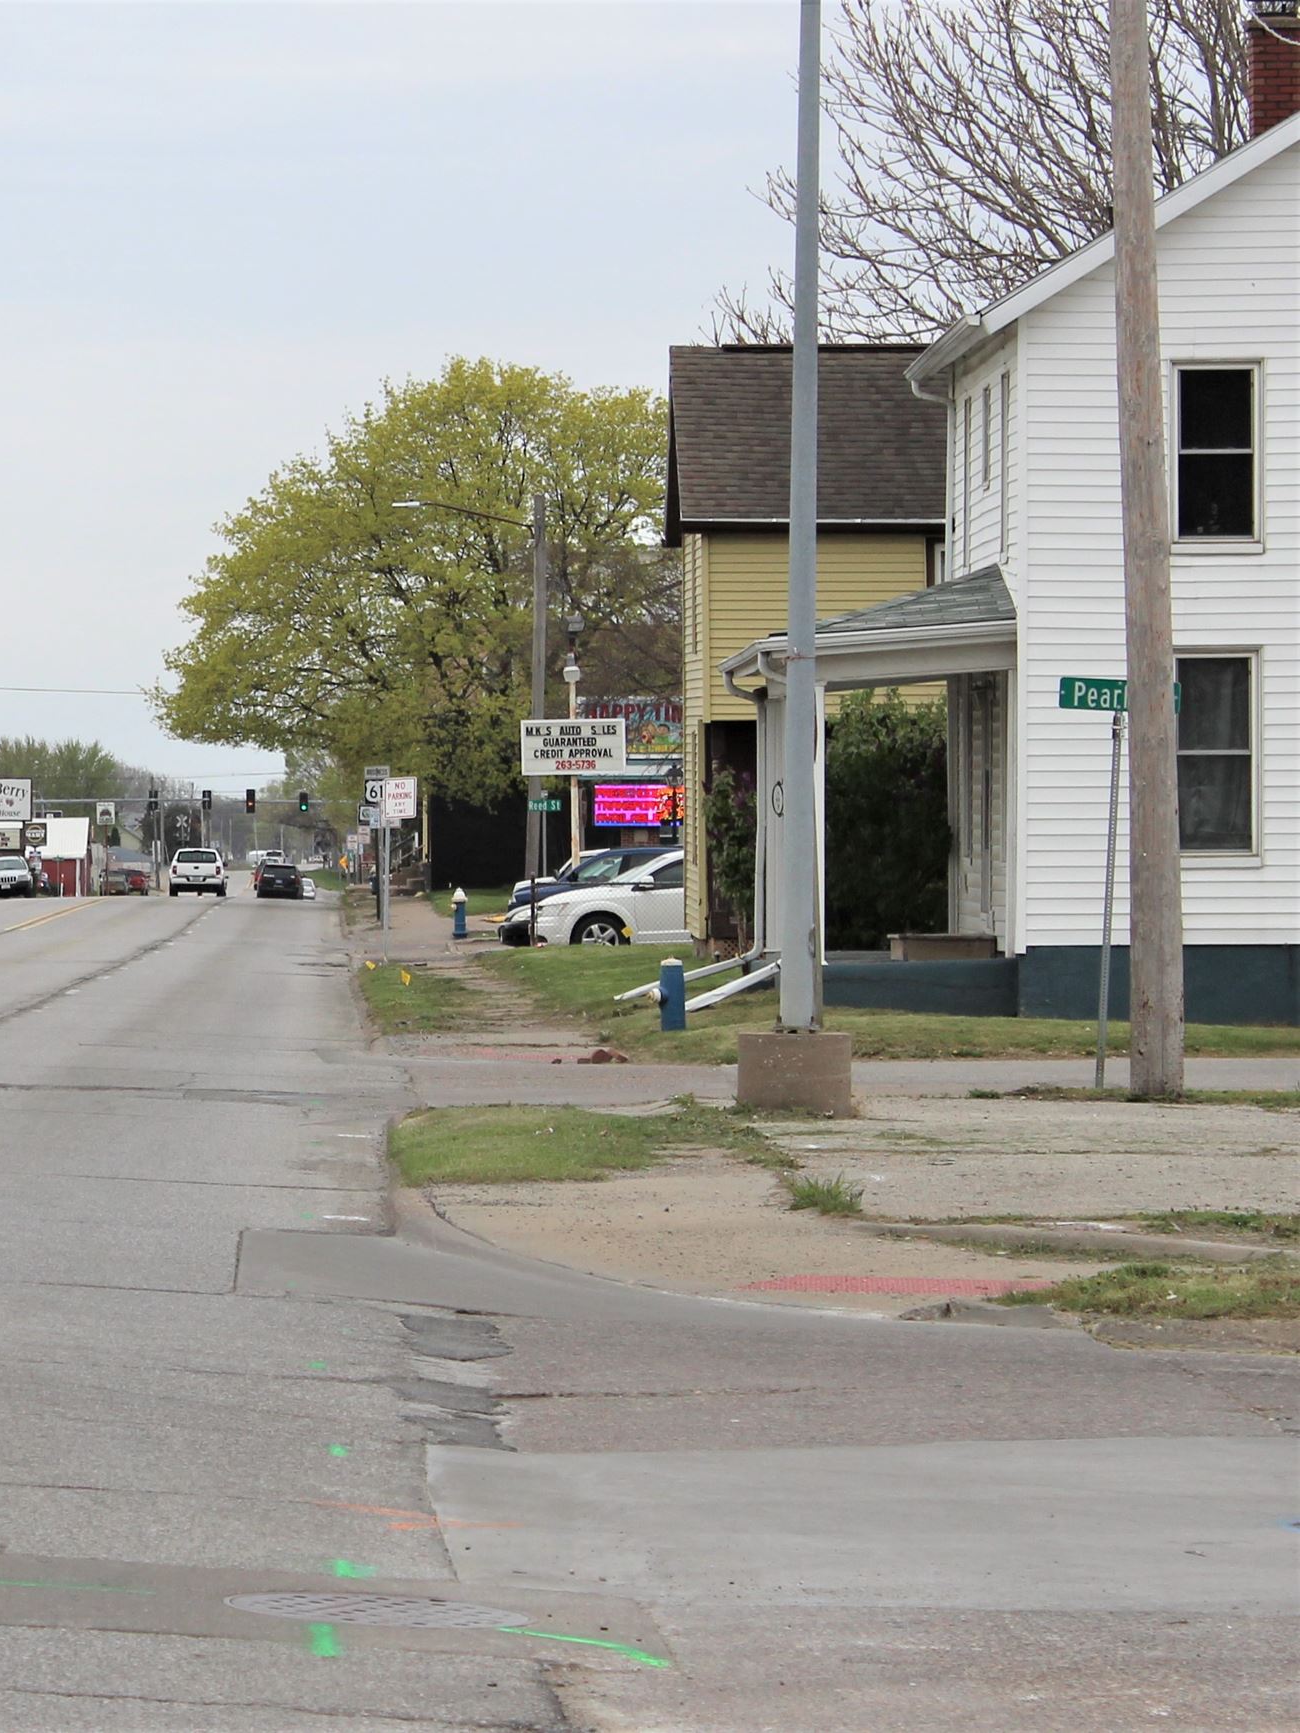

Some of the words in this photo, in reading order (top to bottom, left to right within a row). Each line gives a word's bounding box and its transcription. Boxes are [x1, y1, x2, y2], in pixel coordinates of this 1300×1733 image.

[1074, 681, 1127, 708] Pearl
[560, 726, 582, 736] AUTO
[543, 737, 597, 747] GUARANTEED
[534, 749, 564, 759] CREDIT
[568, 748, 613, 758] APPROVAL
[555, 760, 596, 770] 263-5736
[395, 782, 406, 790] NO
[370, 785, 383, 798] 61
[388, 792, 413, 800] PARKING
[529, 800, 547, 810] Reed
[551, 800, 561, 810] St
